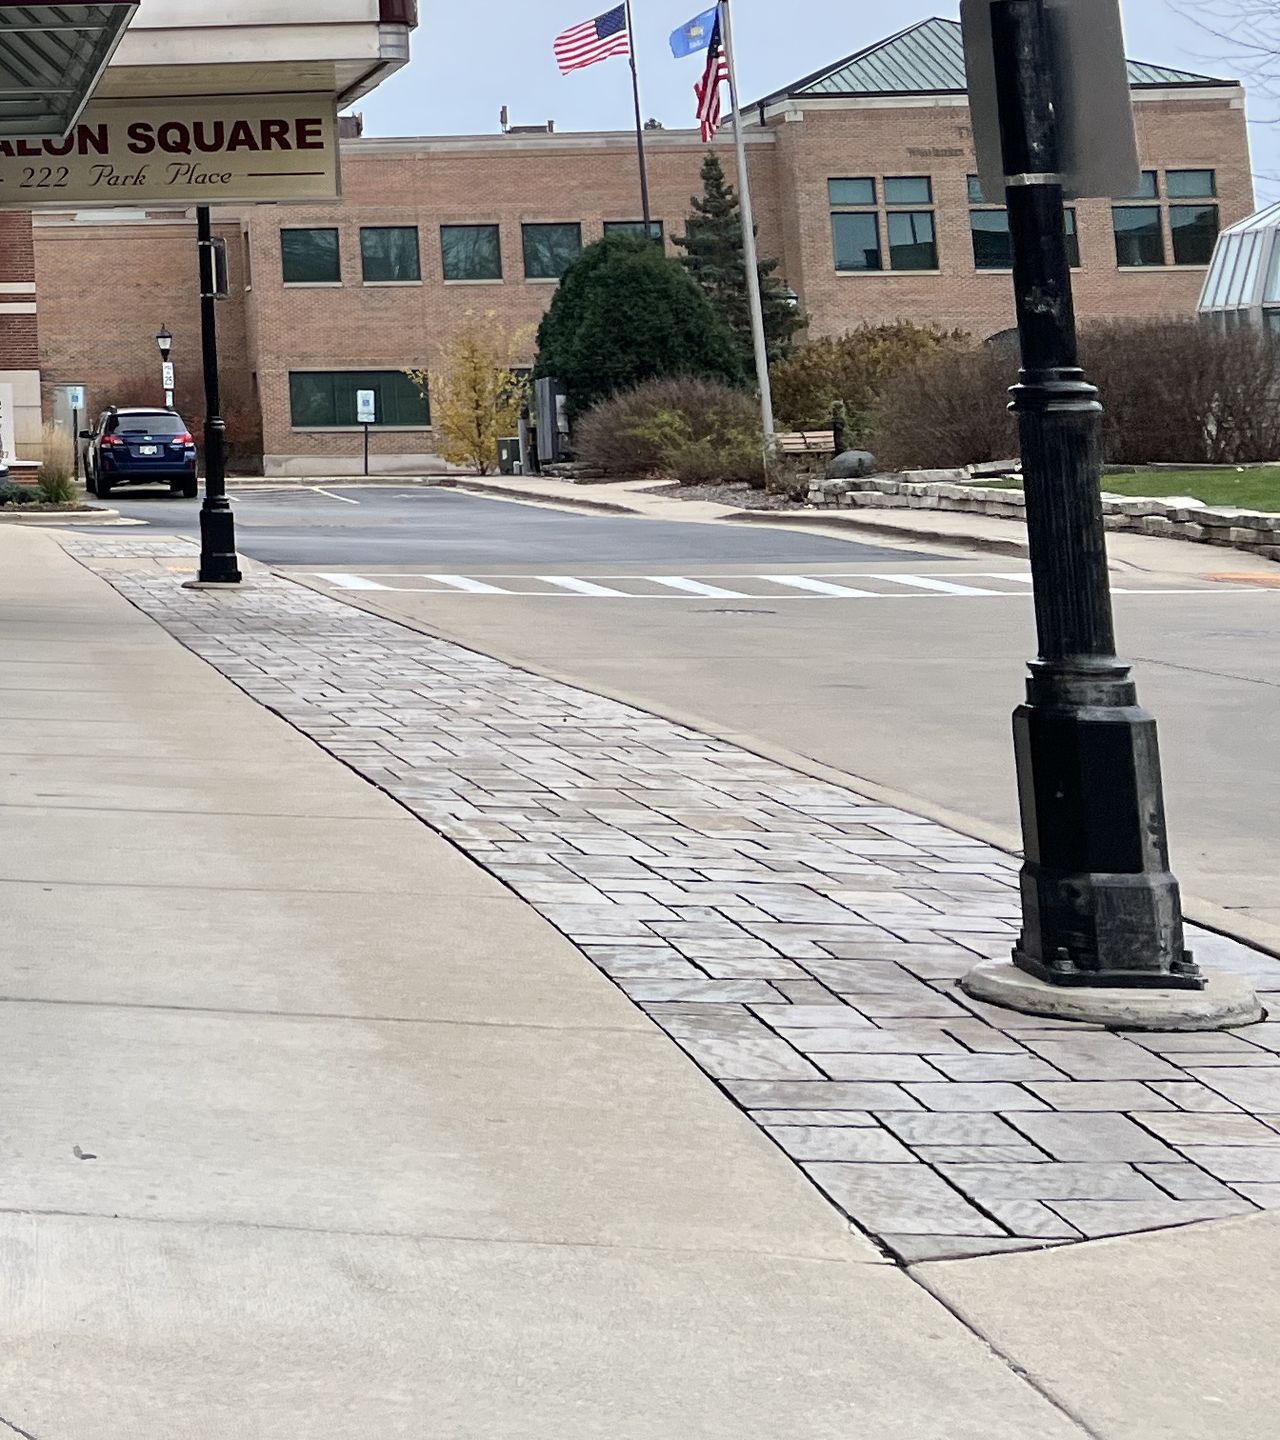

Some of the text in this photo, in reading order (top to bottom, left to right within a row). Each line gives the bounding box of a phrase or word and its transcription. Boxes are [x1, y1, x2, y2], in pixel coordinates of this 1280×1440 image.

[127, 118, 325, 155] SQUARE
[19, 162, 233, 189] 222 Park Place
